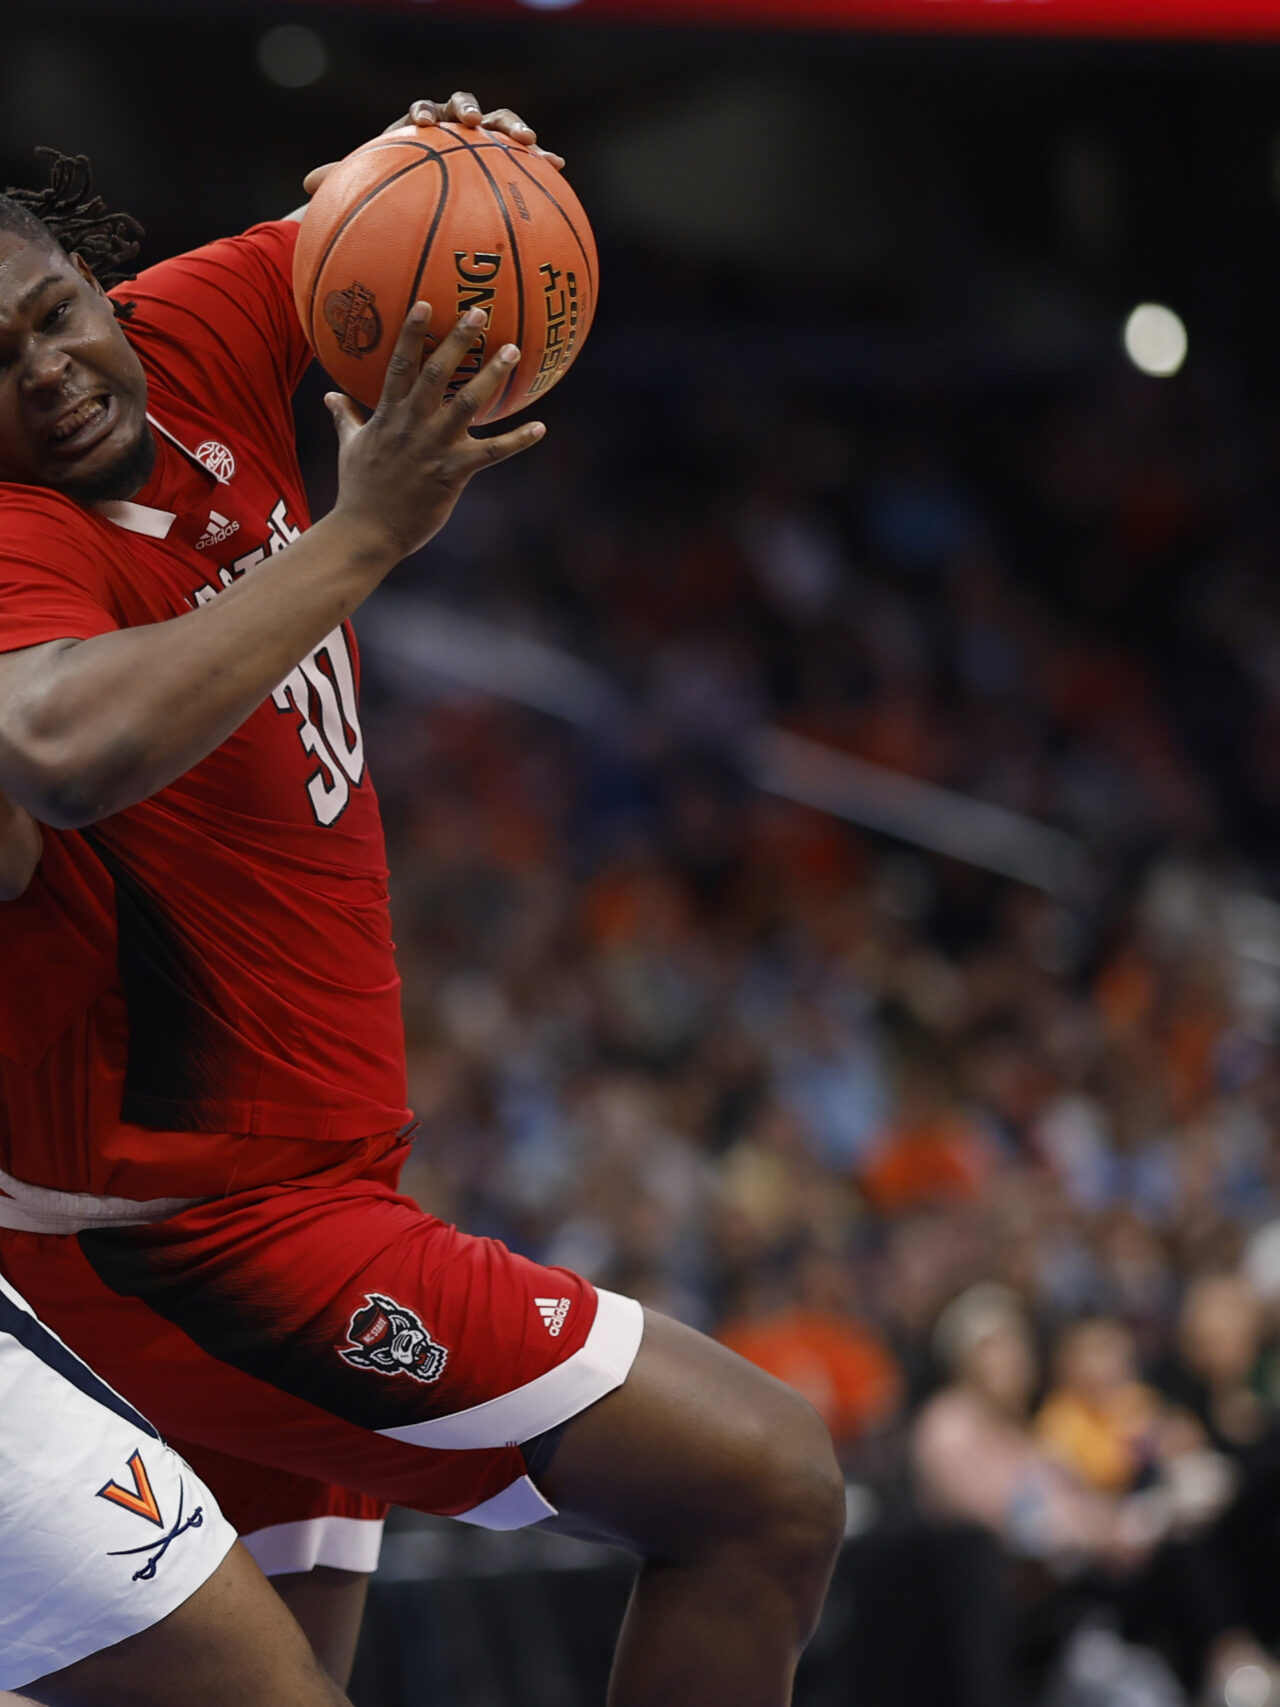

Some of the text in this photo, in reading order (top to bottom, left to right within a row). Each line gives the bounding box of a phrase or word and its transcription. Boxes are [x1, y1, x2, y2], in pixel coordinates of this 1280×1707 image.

[526, 261, 568, 396] EGACY
[195, 520, 240, 550] adidas
[272, 618, 365, 828] 30
[363, 1317, 387, 1344] NC STATE
[548, 1297, 571, 1337] adidas
